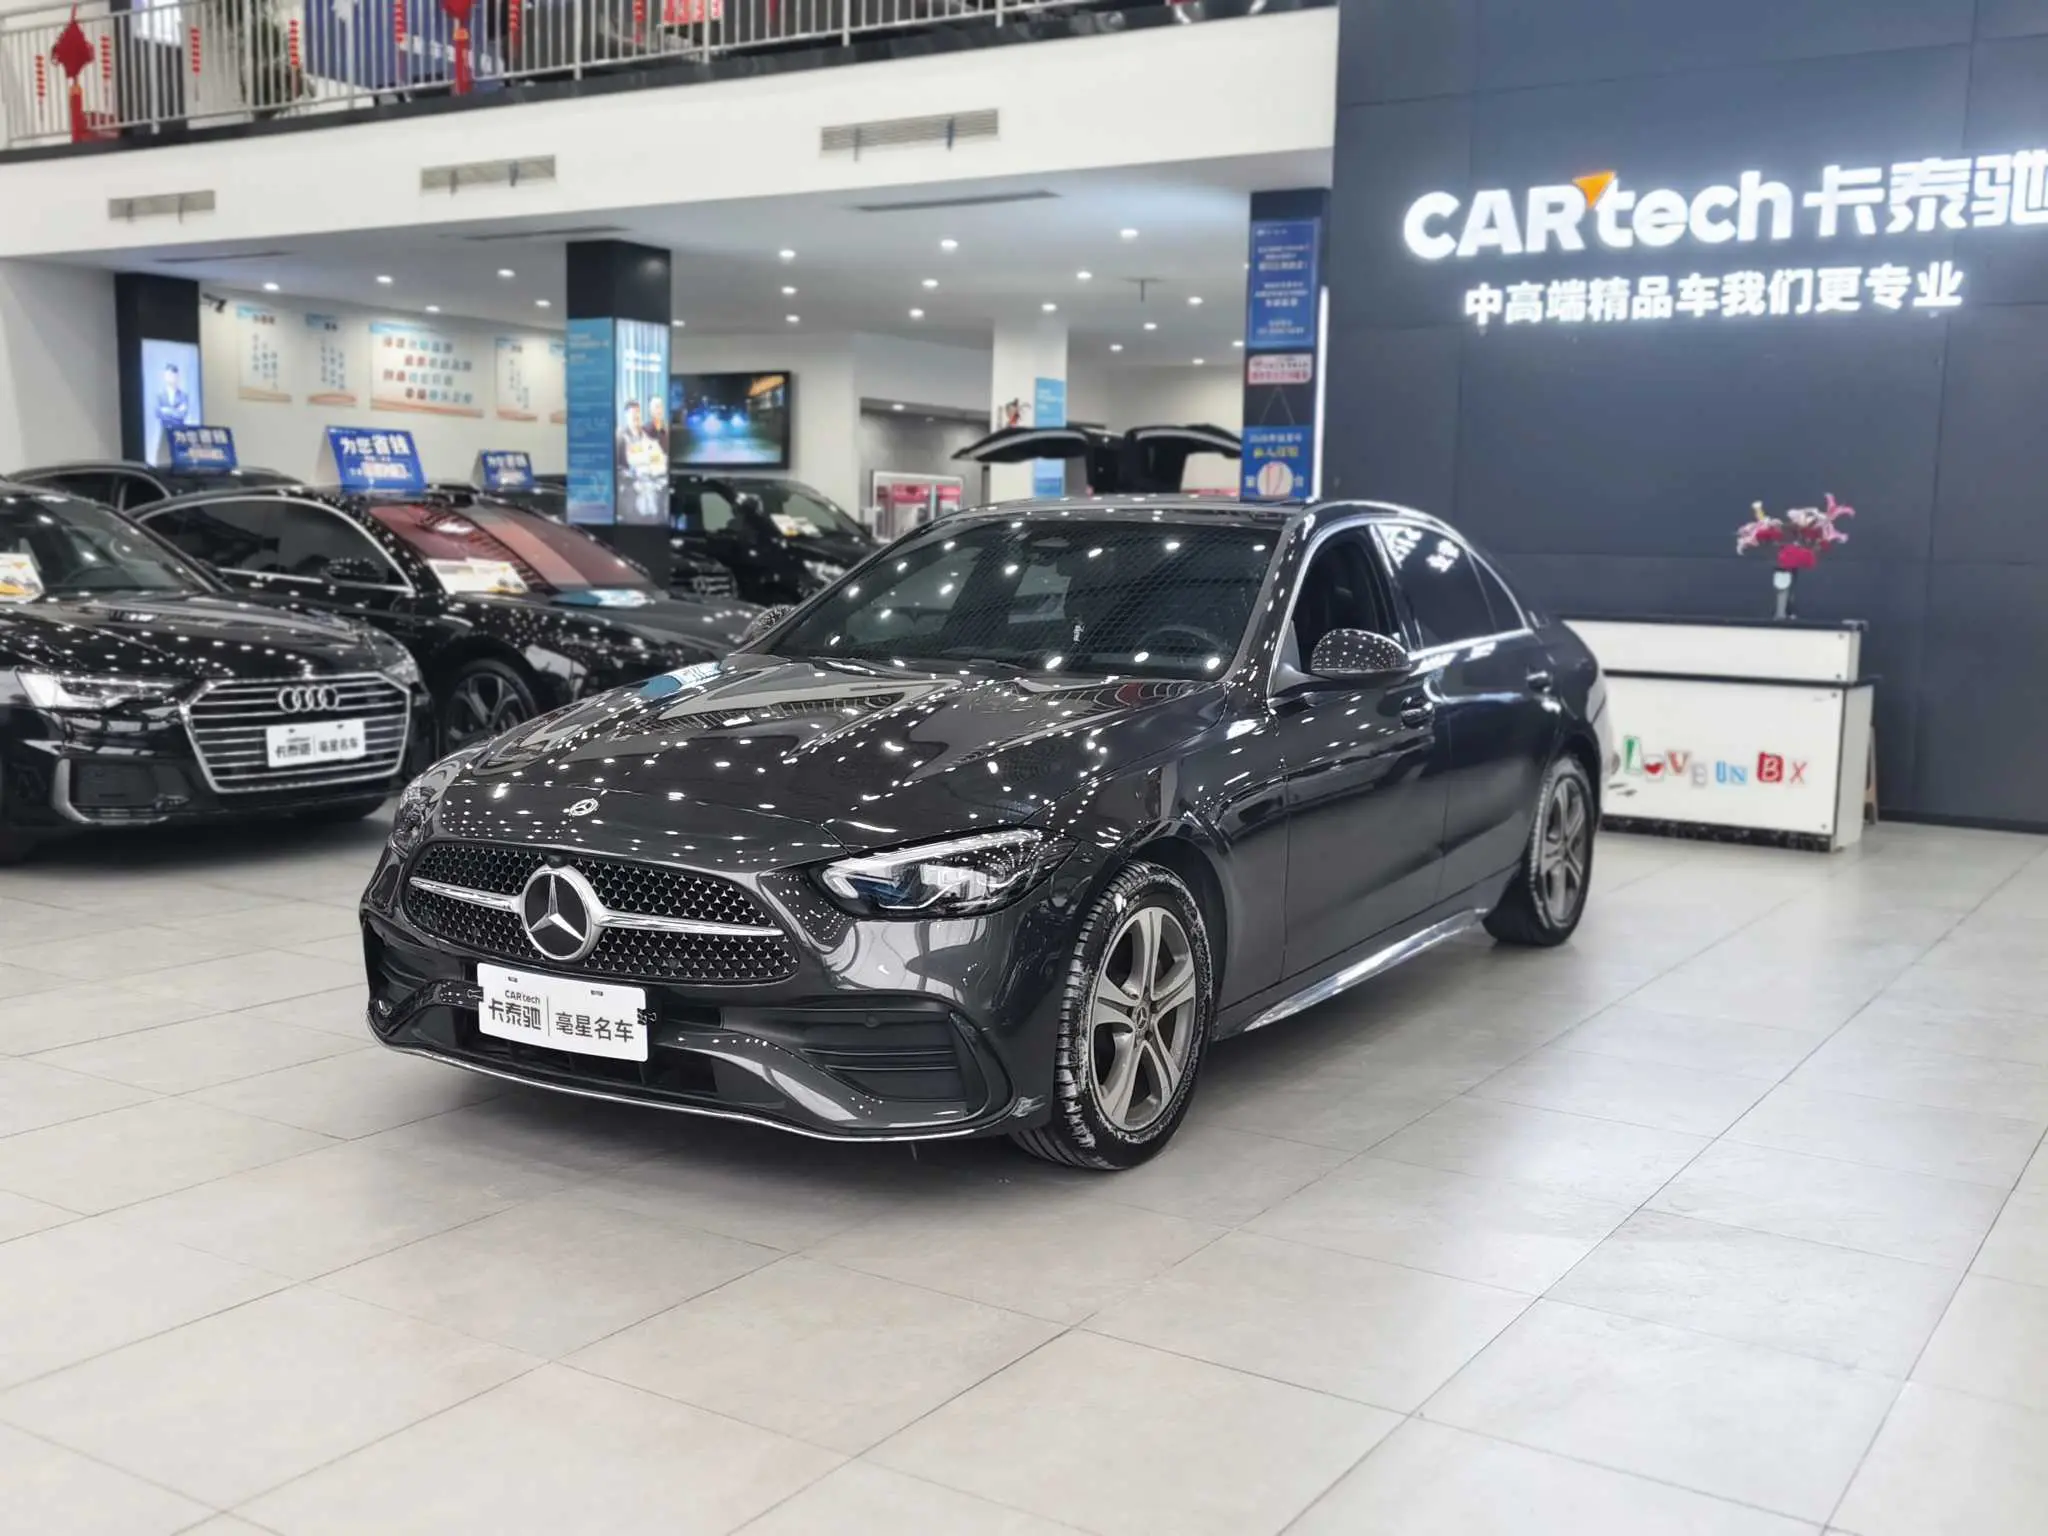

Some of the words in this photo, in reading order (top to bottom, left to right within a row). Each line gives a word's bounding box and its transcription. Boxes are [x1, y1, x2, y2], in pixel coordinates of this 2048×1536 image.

[1404, 170, 1794, 260] CARtech
[1803, 149, 2048, 237] 卡泰驰
[1464, 260, 1964, 327] 中高端精品车我们更专业
[488, 997, 542, 1031] 卡泰驰
